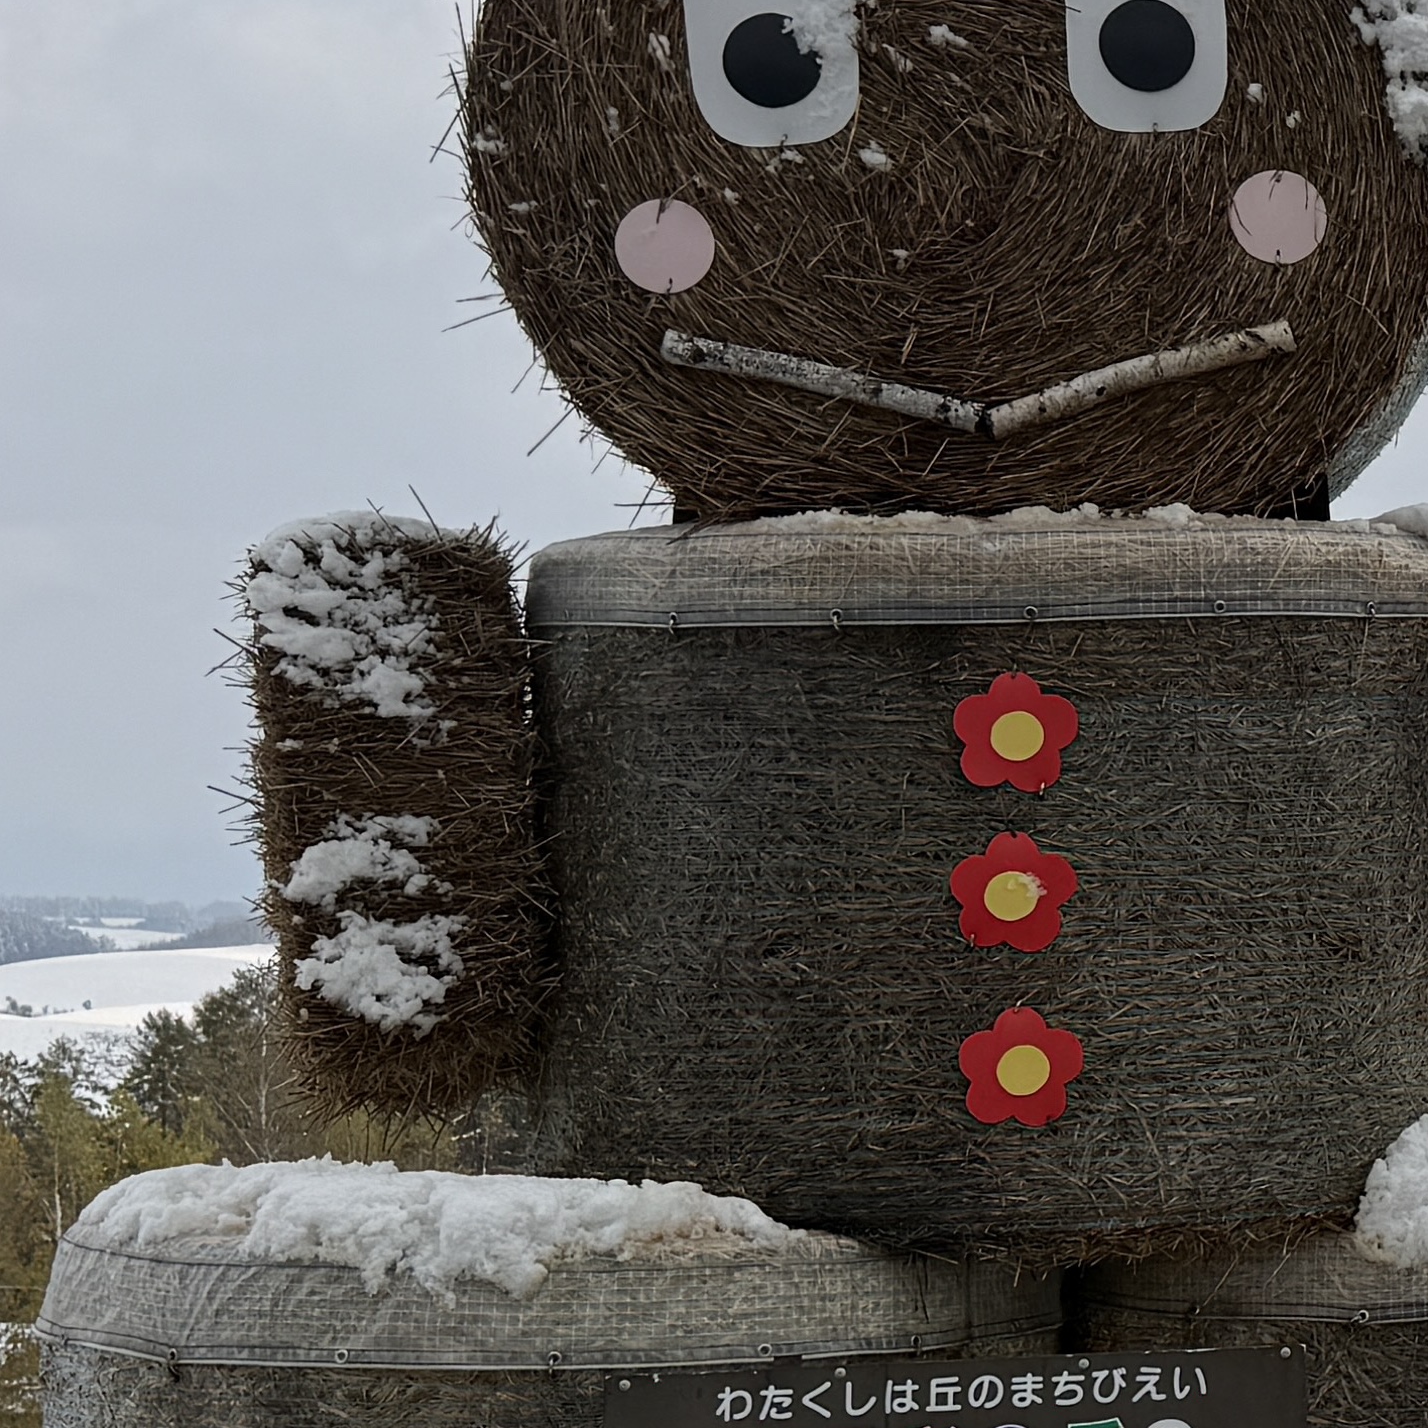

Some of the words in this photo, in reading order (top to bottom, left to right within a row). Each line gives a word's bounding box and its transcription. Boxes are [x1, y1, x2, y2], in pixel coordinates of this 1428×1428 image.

[715, 1366, 1207, 1422] わたくしは丘のまちびえい
